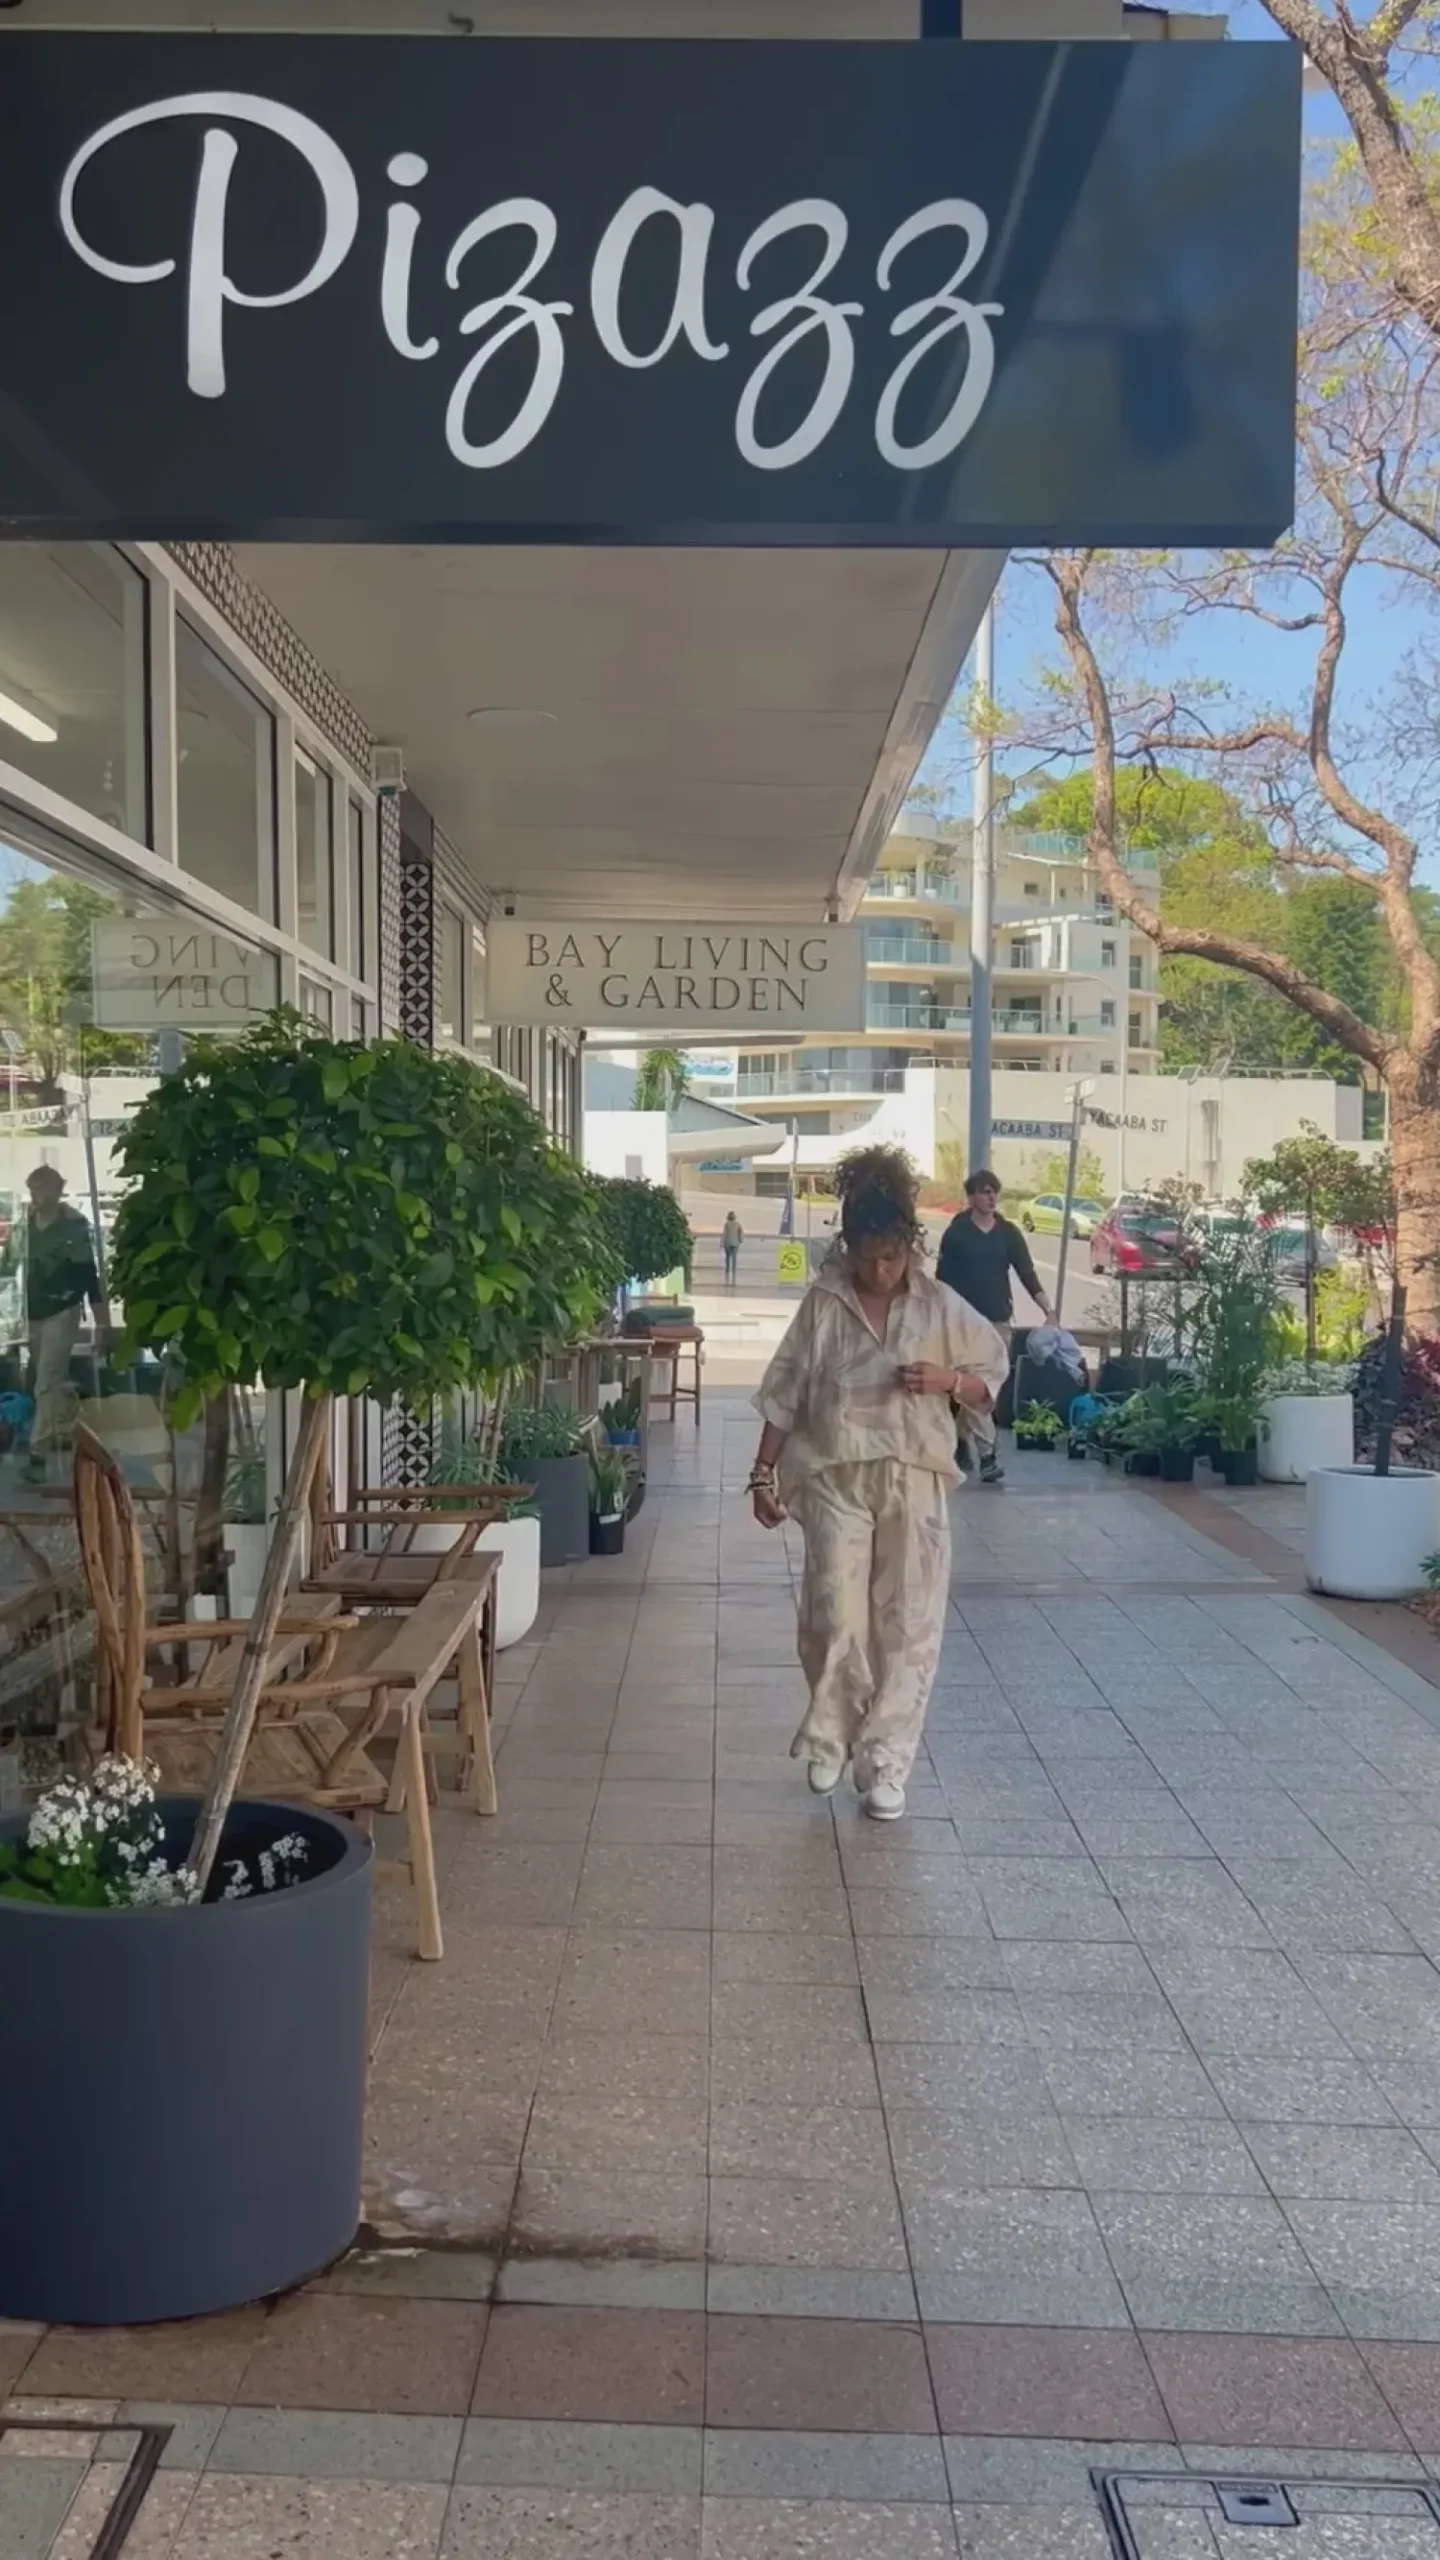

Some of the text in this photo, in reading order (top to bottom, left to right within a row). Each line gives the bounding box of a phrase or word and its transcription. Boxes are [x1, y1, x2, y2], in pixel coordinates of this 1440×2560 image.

[58, 90, 1003, 470] Pizazz
[525, 933, 829, 973] BAY LIVING
[544, 972, 811, 1012] & GARDEN
[1049, 1123, 1064, 1138] ST
[1151, 1118, 1168, 1133] ST
